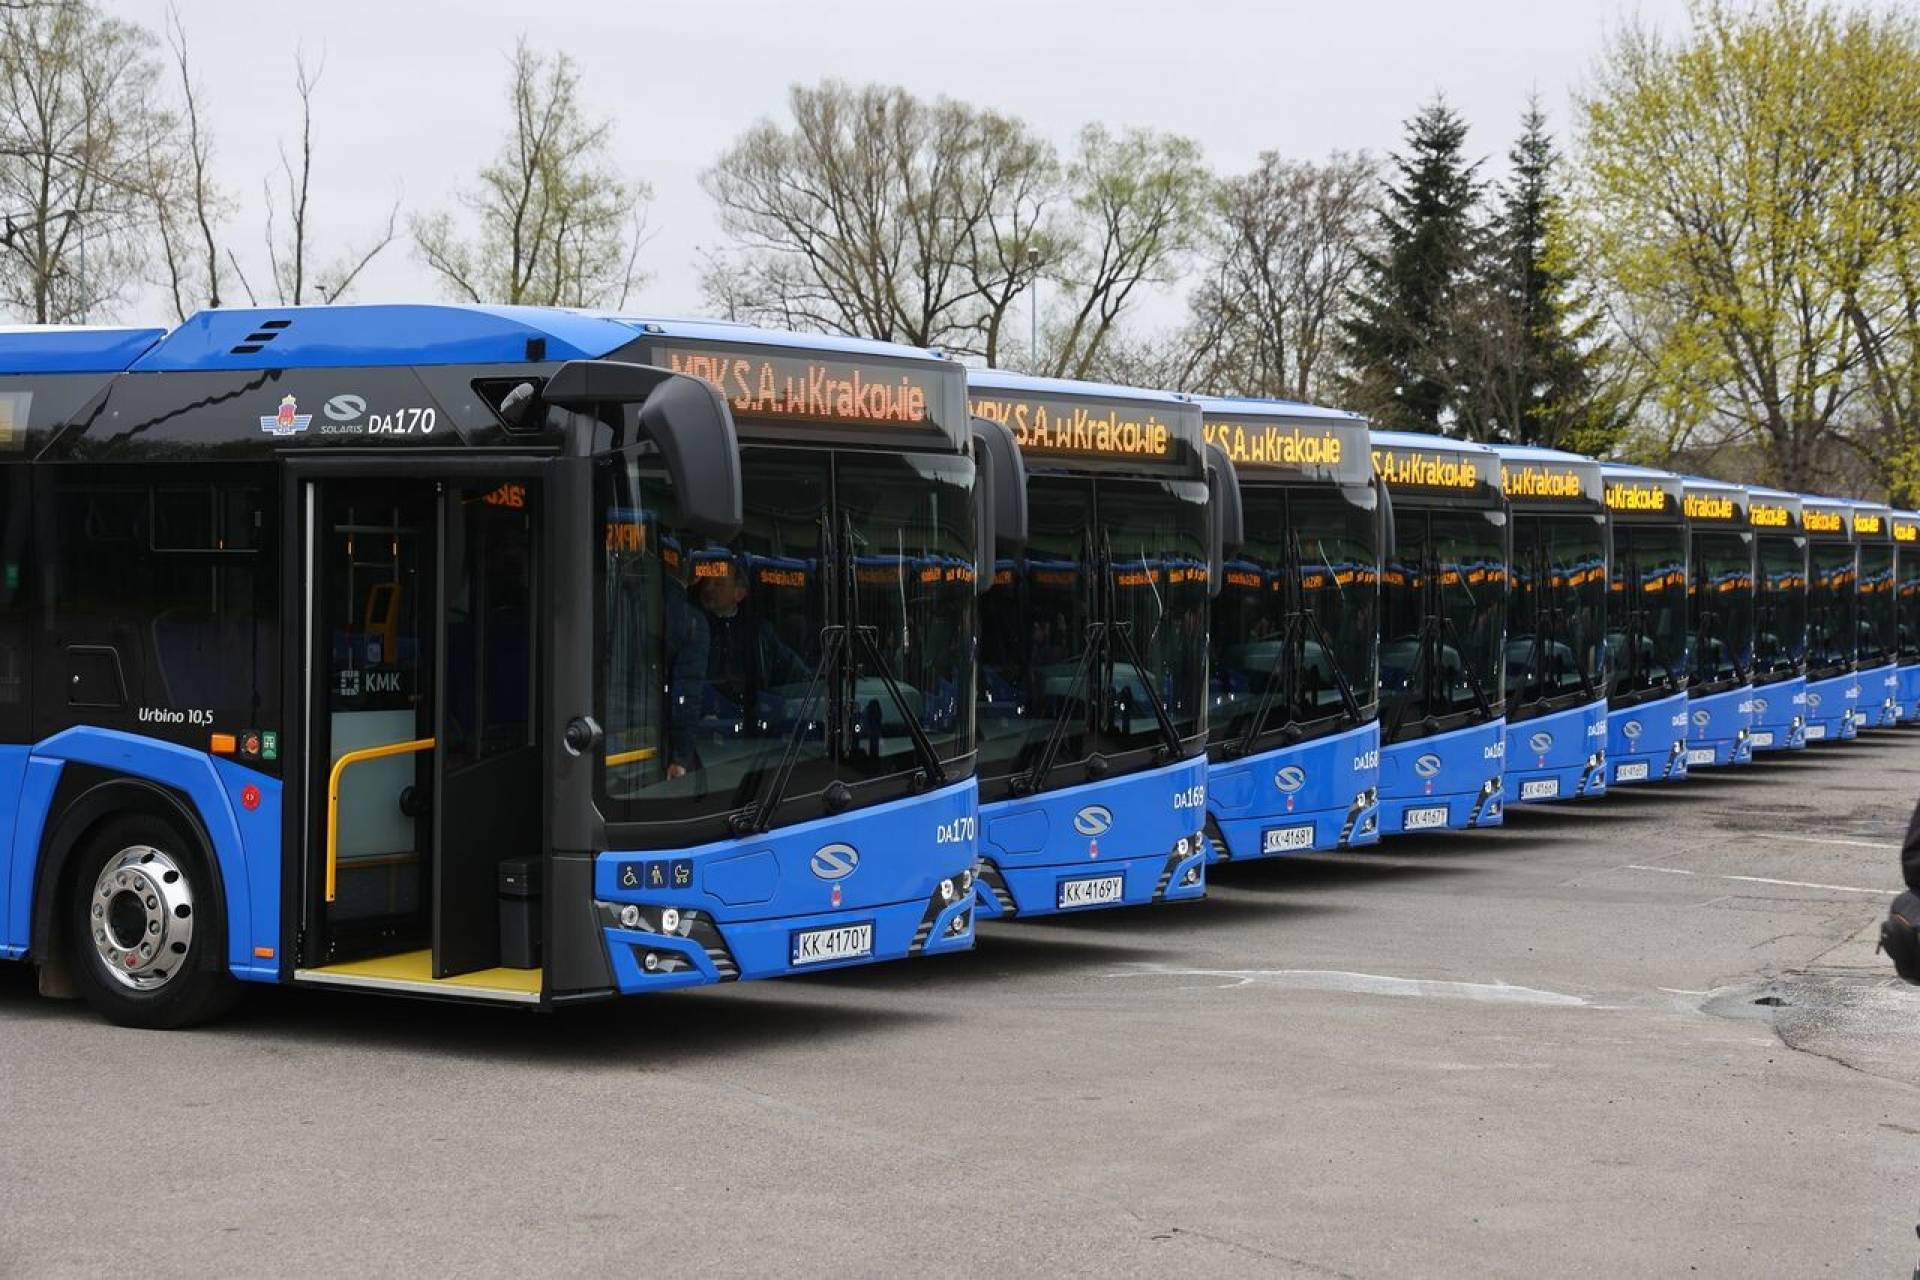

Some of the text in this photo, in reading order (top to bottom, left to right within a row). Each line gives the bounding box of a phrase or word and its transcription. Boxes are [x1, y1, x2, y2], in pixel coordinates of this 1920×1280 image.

[733, 359, 784, 411] S.A.
[787, 376, 805, 414] w
[809, 365, 925, 421] Krakowie
[320, 425, 363, 435] SOLARIS
[368, 407, 436, 433] DA170
[1016, 404, 1053, 447] S.A.
[1056, 417, 1071, 448] w
[1074, 408, 1167, 454] Krakowie
[1252, 435, 1264, 461] w
[1266, 426, 1341, 463] Krakowie
[1400, 459, 1410, 484] w
[1412, 453, 1476, 488] Krakowie
[1513, 473, 1522, 495] w
[1523, 466, 1579, 497] Krakowie
[1615, 482, 1664, 510] Krakowie
[1687, 493, 1732, 518] Krakowie
[1749, 503, 1788, 526] rakowie
[365, 671, 401, 693] KMK
[138, 707, 214, 727] Urbino 10,5
[1174, 785, 1205, 809] DA169
[936, 816, 975, 843] DA170
[1269, 831, 1282, 847] KK
[1067, 879, 1120, 902] KK 4169Y
[802, 927, 869, 957] KK 4170Y
